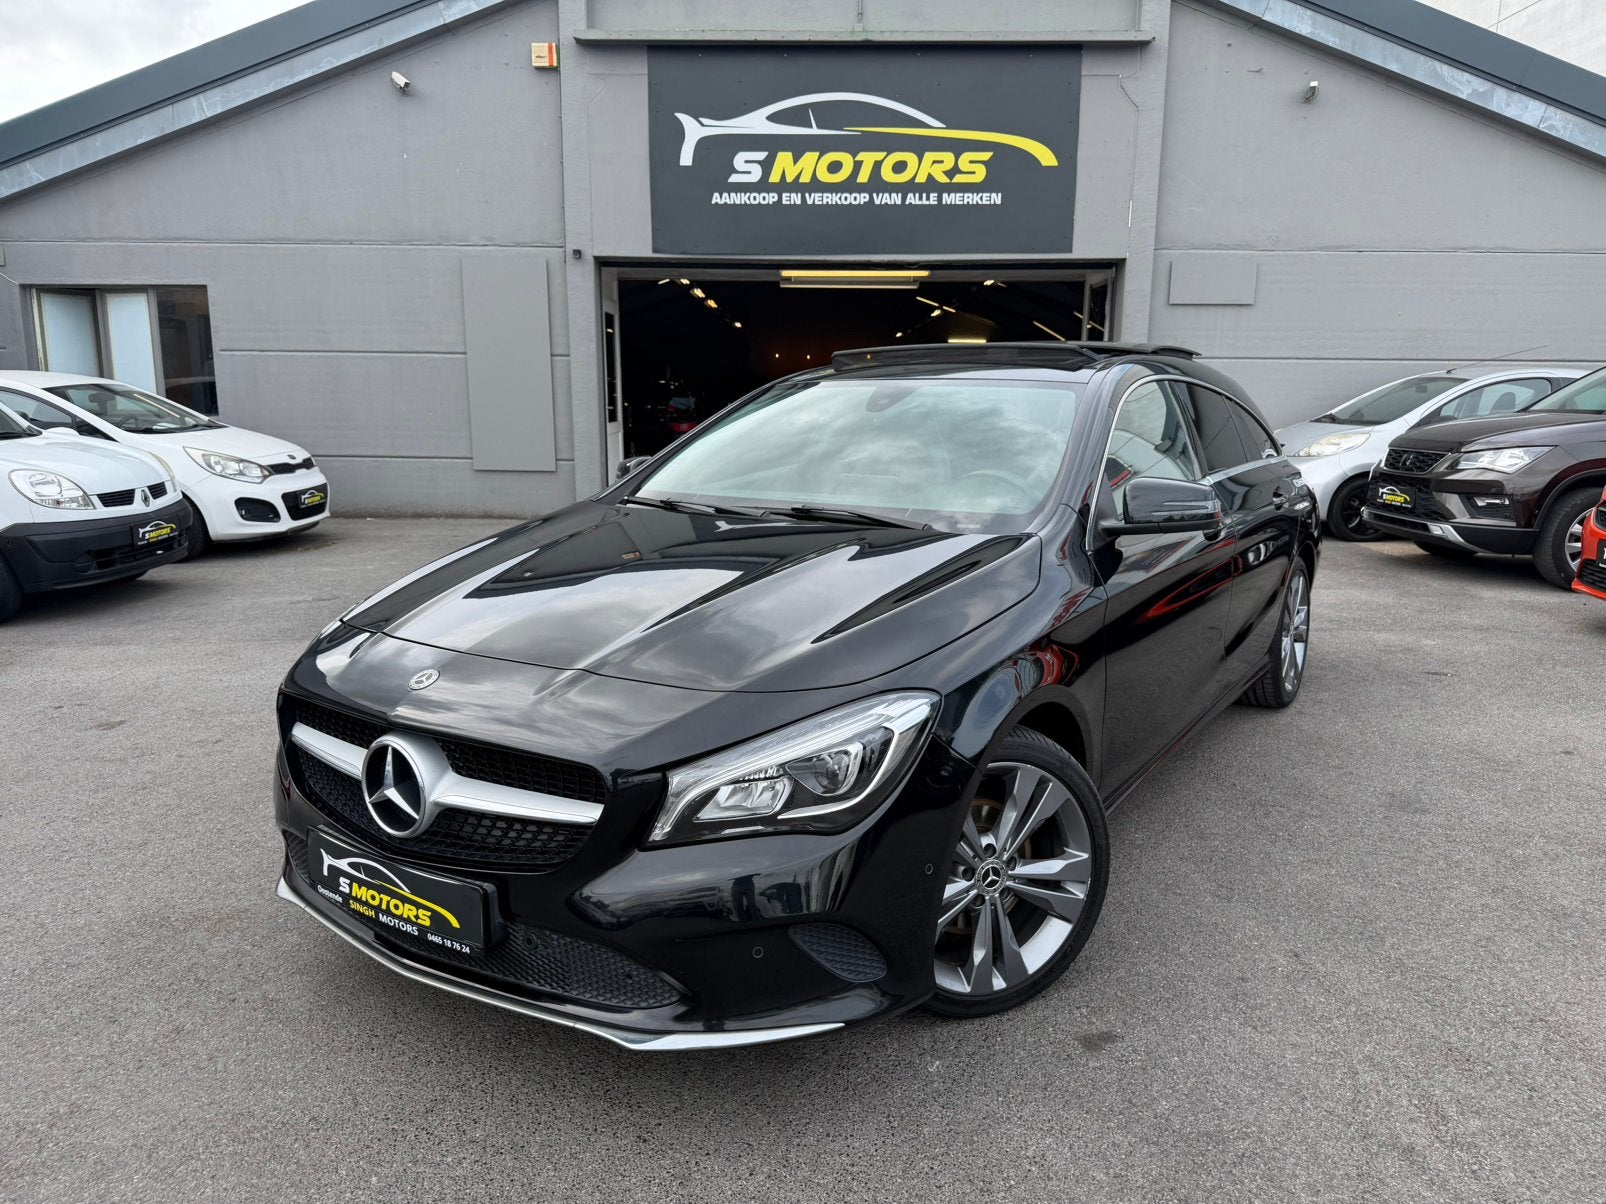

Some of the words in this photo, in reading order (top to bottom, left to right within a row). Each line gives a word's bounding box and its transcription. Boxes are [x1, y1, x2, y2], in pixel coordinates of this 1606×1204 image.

[727, 151, 769, 183] S
[768, 151, 994, 183] MOTORS
[711, 192, 779, 205] AANKOOP
[782, 192, 802, 205] EN
[805, 192, 870, 205] VERKOOP
[872, 192, 902, 205] VAN
[905, 192, 938, 206] ALLE
[942, 192, 1002, 206] MERKEN
[339, 876, 351, 894] S
[351, 882, 431, 927] MOTORS
[349, 900, 375, 918] SINGH
[378, 913, 419, 936] MOTORS
[452, 941, 461, 951] 76
[461, 944, 470, 954] 24
